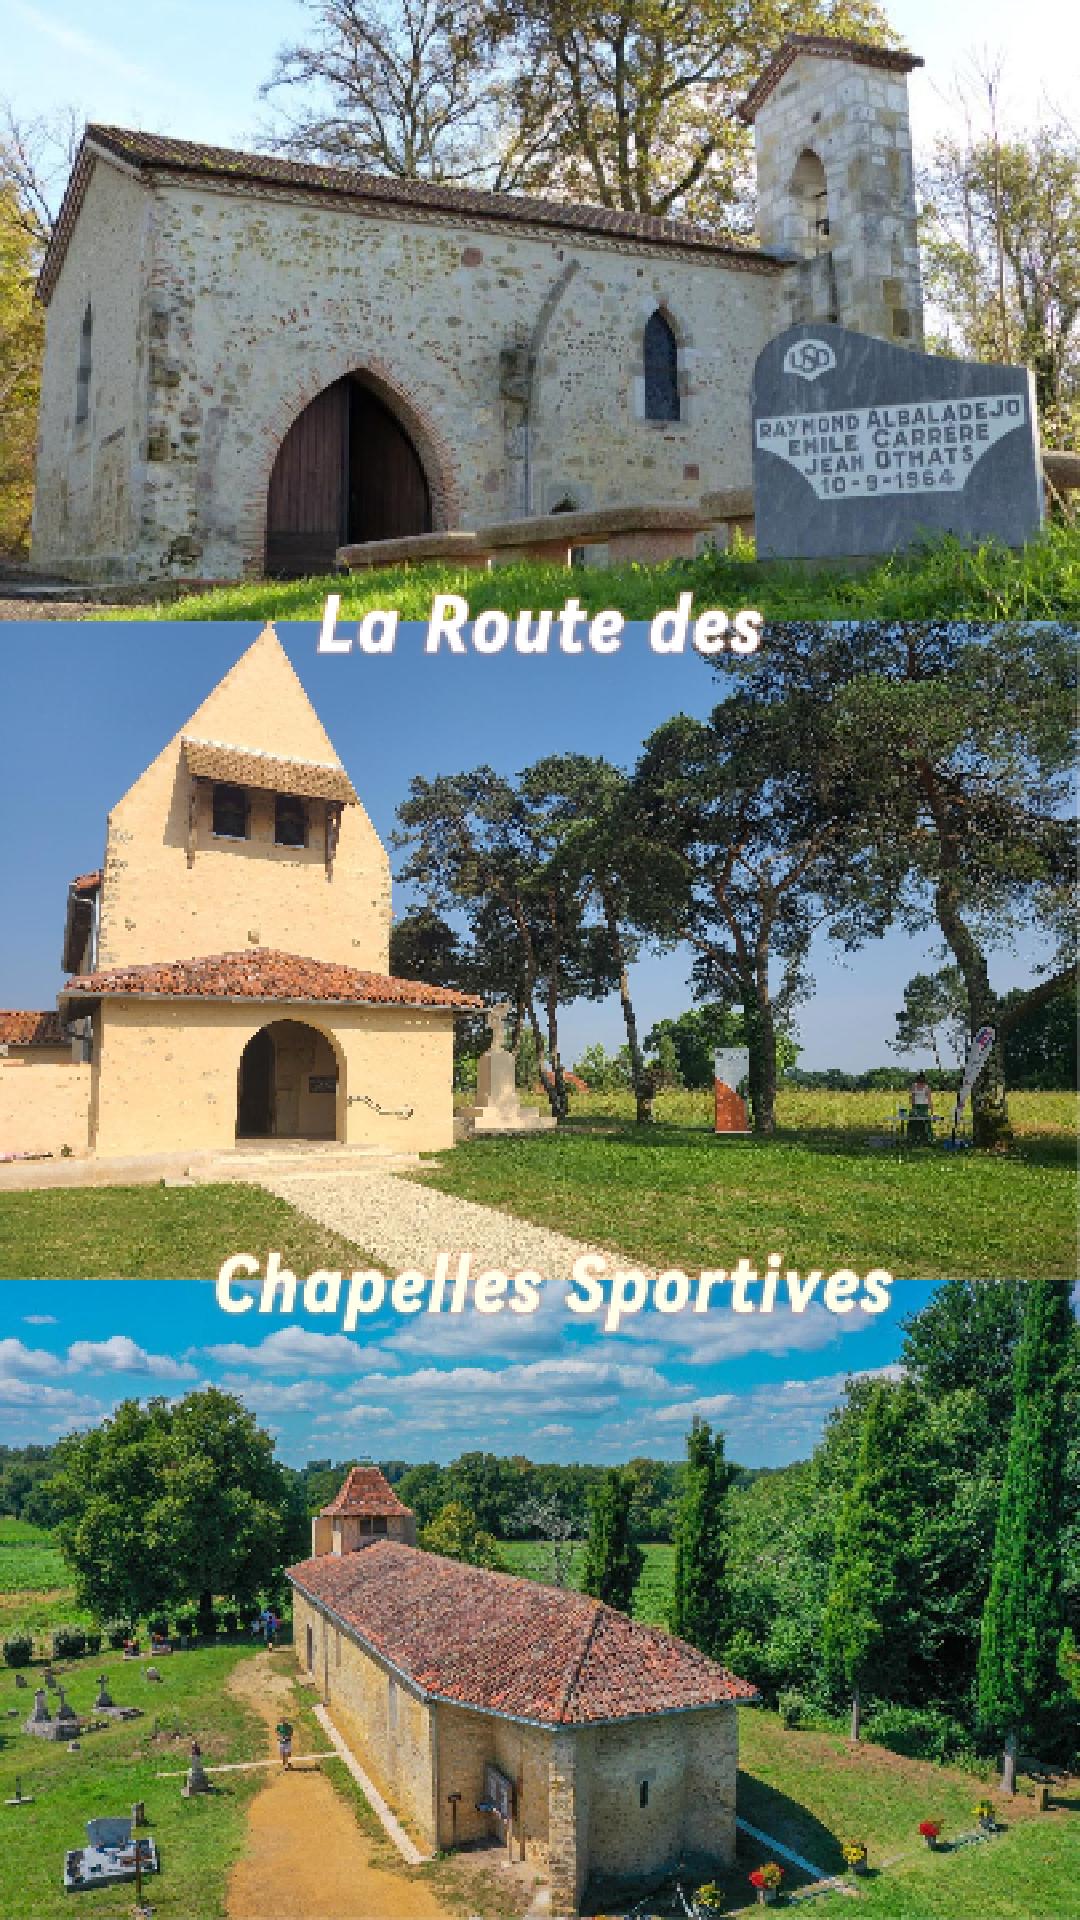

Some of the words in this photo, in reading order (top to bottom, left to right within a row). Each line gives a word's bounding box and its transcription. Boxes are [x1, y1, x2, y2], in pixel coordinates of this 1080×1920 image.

[760, 413, 859, 437] RAYMOND
[867, 400, 1020, 429] ALBALADEJO
[789, 434, 859, 456] EMILE
[805, 453, 864, 475] JEAN
[875, 445, 974, 469] OTHATS
